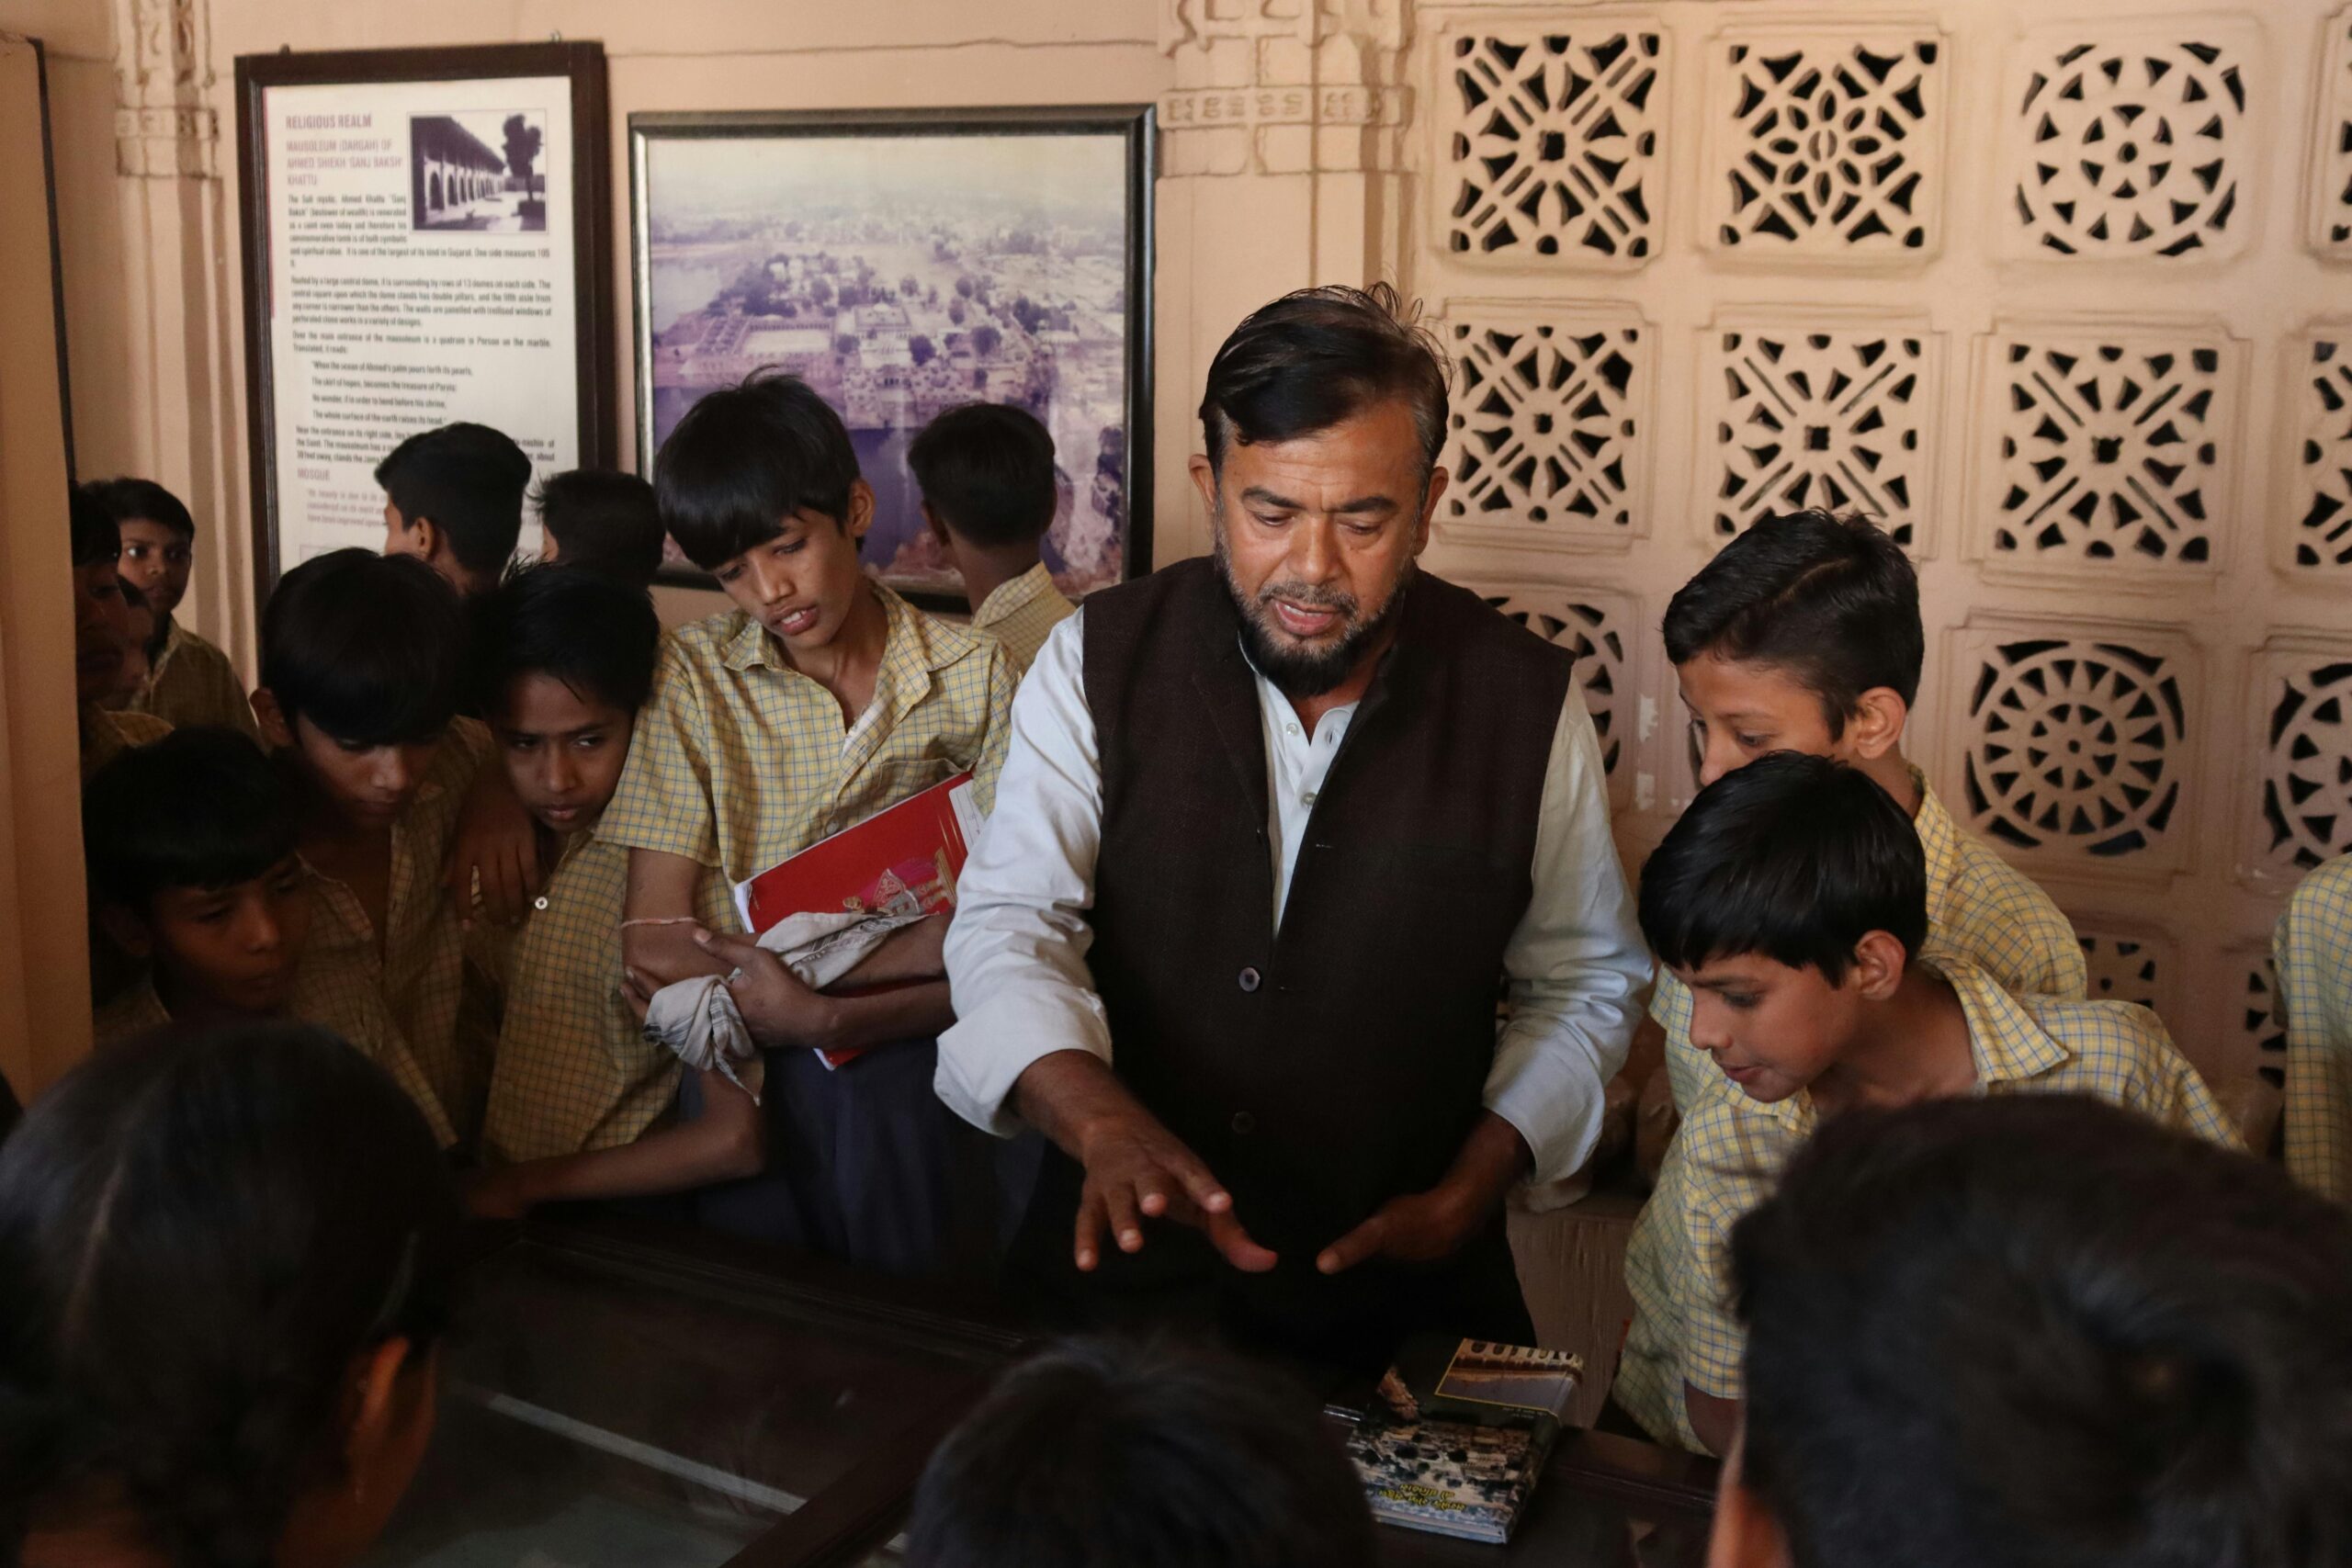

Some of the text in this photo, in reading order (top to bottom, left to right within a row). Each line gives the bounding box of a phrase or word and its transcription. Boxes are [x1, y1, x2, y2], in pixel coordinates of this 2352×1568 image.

[286, 113, 372, 130] RELIGIOUS REALM
[287, 140, 337, 152] MAUSOLEUM
[380, 138, 393, 152] OF
[287, 156, 315, 170] AHMED
[287, 174, 318, 186] KHATTU
[503, 249, 536, 258] measures
[514, 308, 543, 316] windows
[297, 468, 330, 480] MOSQUE
